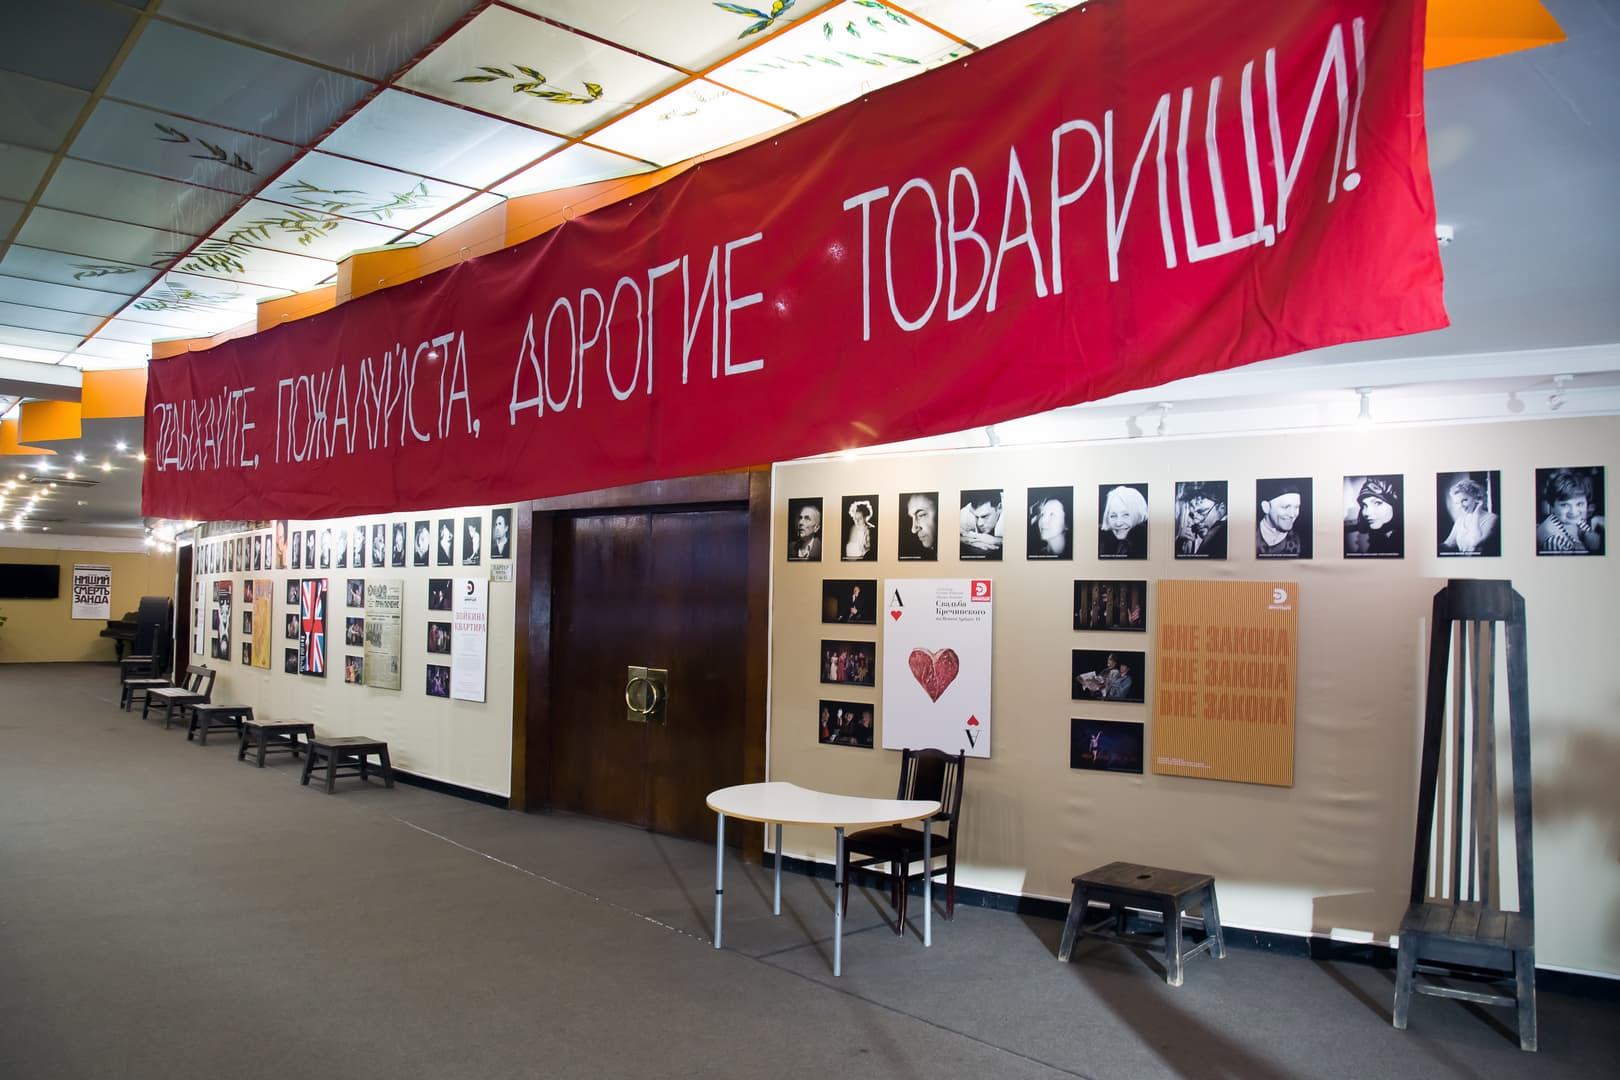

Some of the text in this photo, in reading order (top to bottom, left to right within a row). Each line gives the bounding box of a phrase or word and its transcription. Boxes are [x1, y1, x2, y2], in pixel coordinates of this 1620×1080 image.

[275, 330, 481, 465] ПОЖАЛУЙСТА,
[509, 231, 764, 426] ДОРОГИЕ
[842, 16, 1365, 341] ТОВАРИЩИ!
[74, 586, 110, 595] СМЕРТЬ
[74, 595, 109, 604] ЗАНДА
[1161, 623, 1290, 657] ВНЕ ЗАКОНА
[1161, 656, 1289, 690] ВНЕ ЗАКОНА
[1159, 688, 1288, 726] ВНЕ ЗАКОНА
